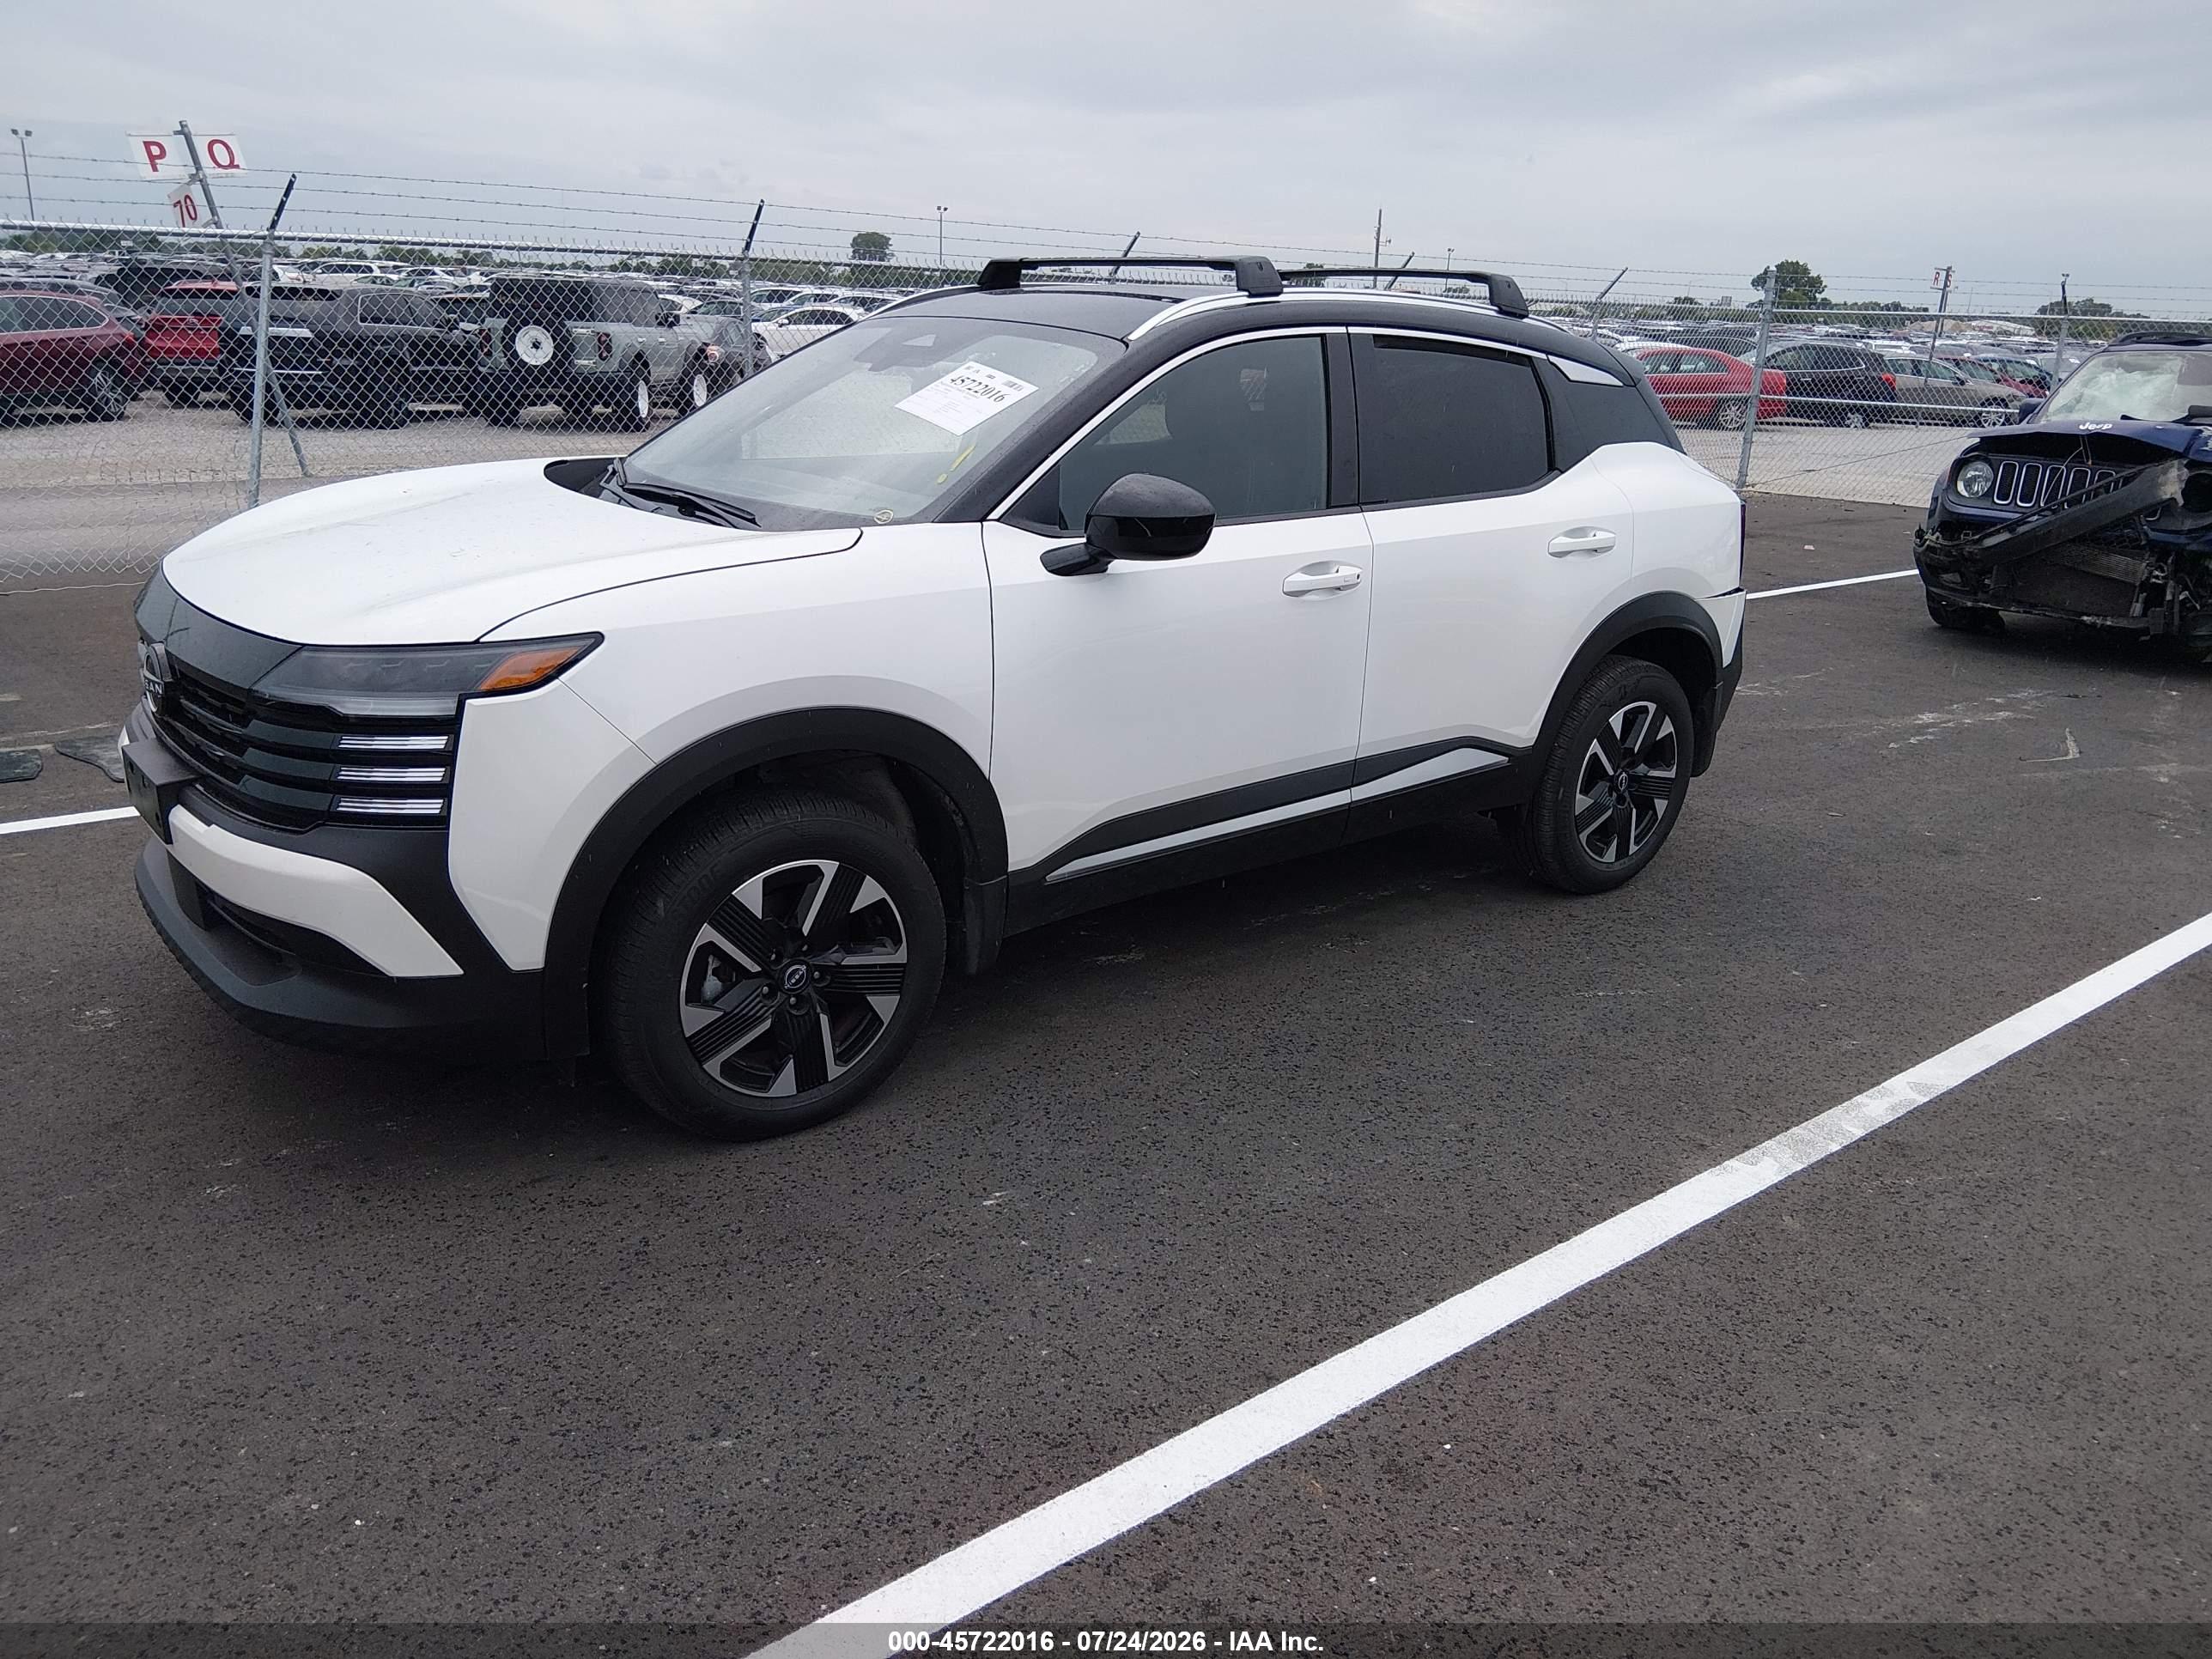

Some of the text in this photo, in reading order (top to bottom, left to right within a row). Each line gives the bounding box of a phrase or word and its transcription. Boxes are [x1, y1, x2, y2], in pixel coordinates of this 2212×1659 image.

[143, 141, 167, 172] P
[207, 138, 240, 170] Q
[173, 194, 198, 228] 70
[1933, 271, 1941, 286] R
[949, 375, 1010, 403] 45722016
[2079, 422, 2113, 430] Jeep
